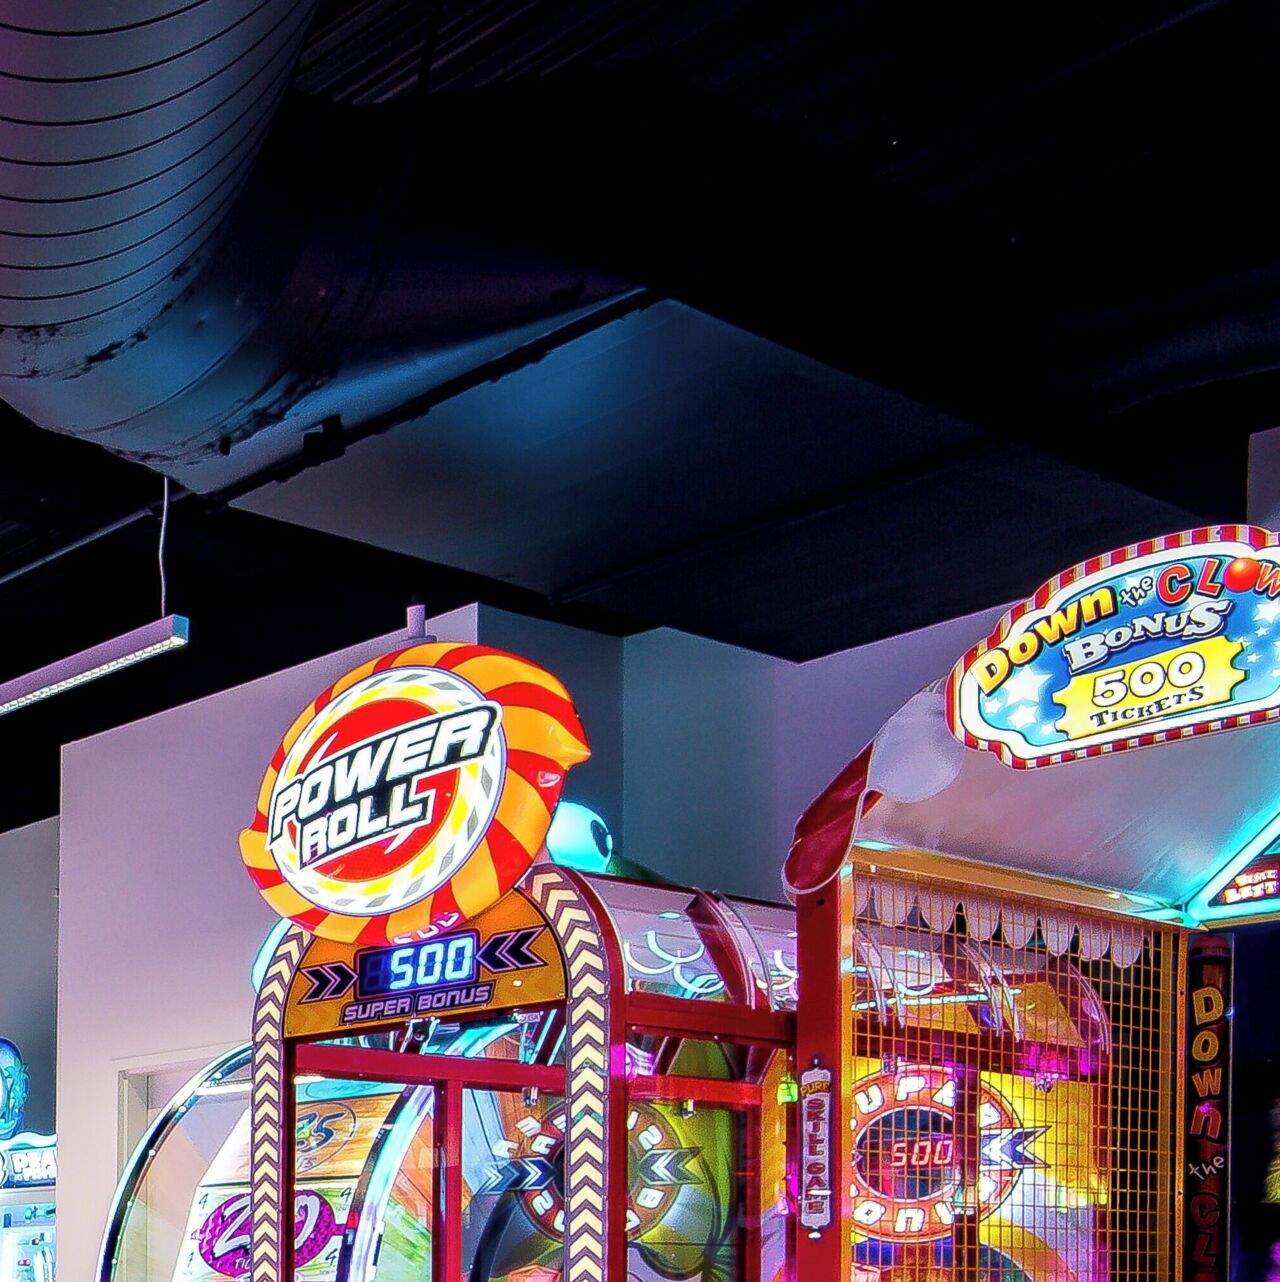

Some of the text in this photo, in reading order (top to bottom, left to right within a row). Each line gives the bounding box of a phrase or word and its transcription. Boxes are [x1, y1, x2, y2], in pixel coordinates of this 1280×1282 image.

[1120, 576, 1154, 607] the
[1092, 651, 1206, 708] 500
[270, 707, 497, 845] POWER
[300, 773, 435, 870] ROLL
[389, 934, 475, 990] 500
[344, 985, 490, 1022] SUPER BONUS
[800, 1081, 831, 1098] PURE
[890, 1140, 953, 1167] 500
